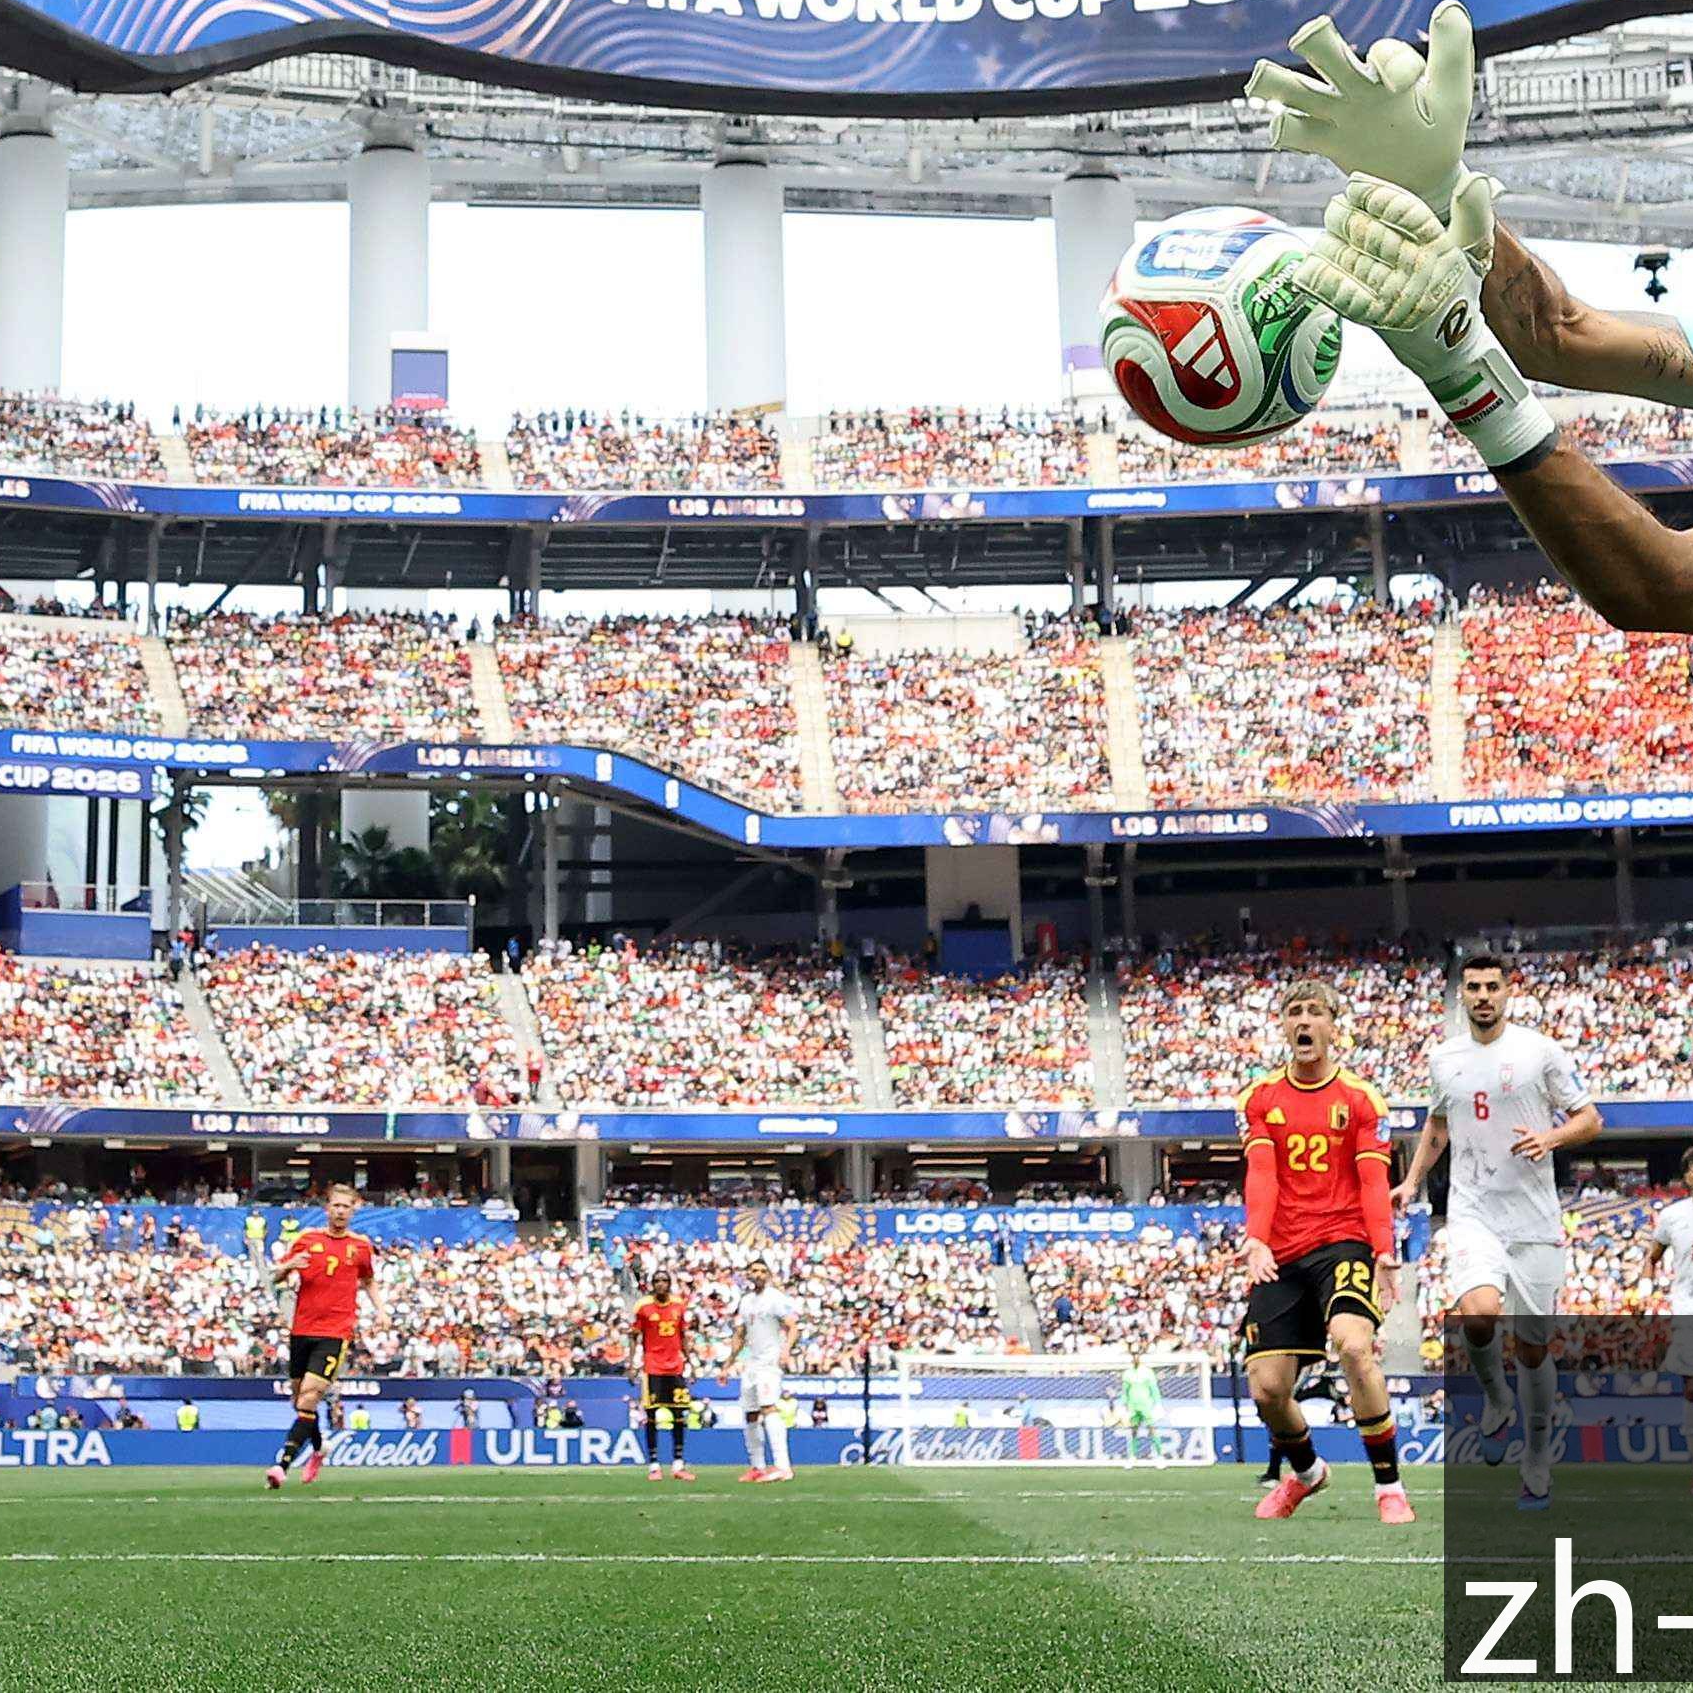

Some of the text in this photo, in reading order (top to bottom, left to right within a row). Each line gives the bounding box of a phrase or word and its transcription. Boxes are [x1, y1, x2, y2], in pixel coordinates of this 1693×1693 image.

[51, 767, 141, 793] 2026
[1474, 1091, 1489, 1120] 6
[1287, 1134, 1329, 1173] 22
[895, 1212, 967, 1233] LOS
[327, 1255, 339, 1276] 7
[1334, 1260, 1370, 1293] 22
[485, 1428, 646, 1465] ULTRA
